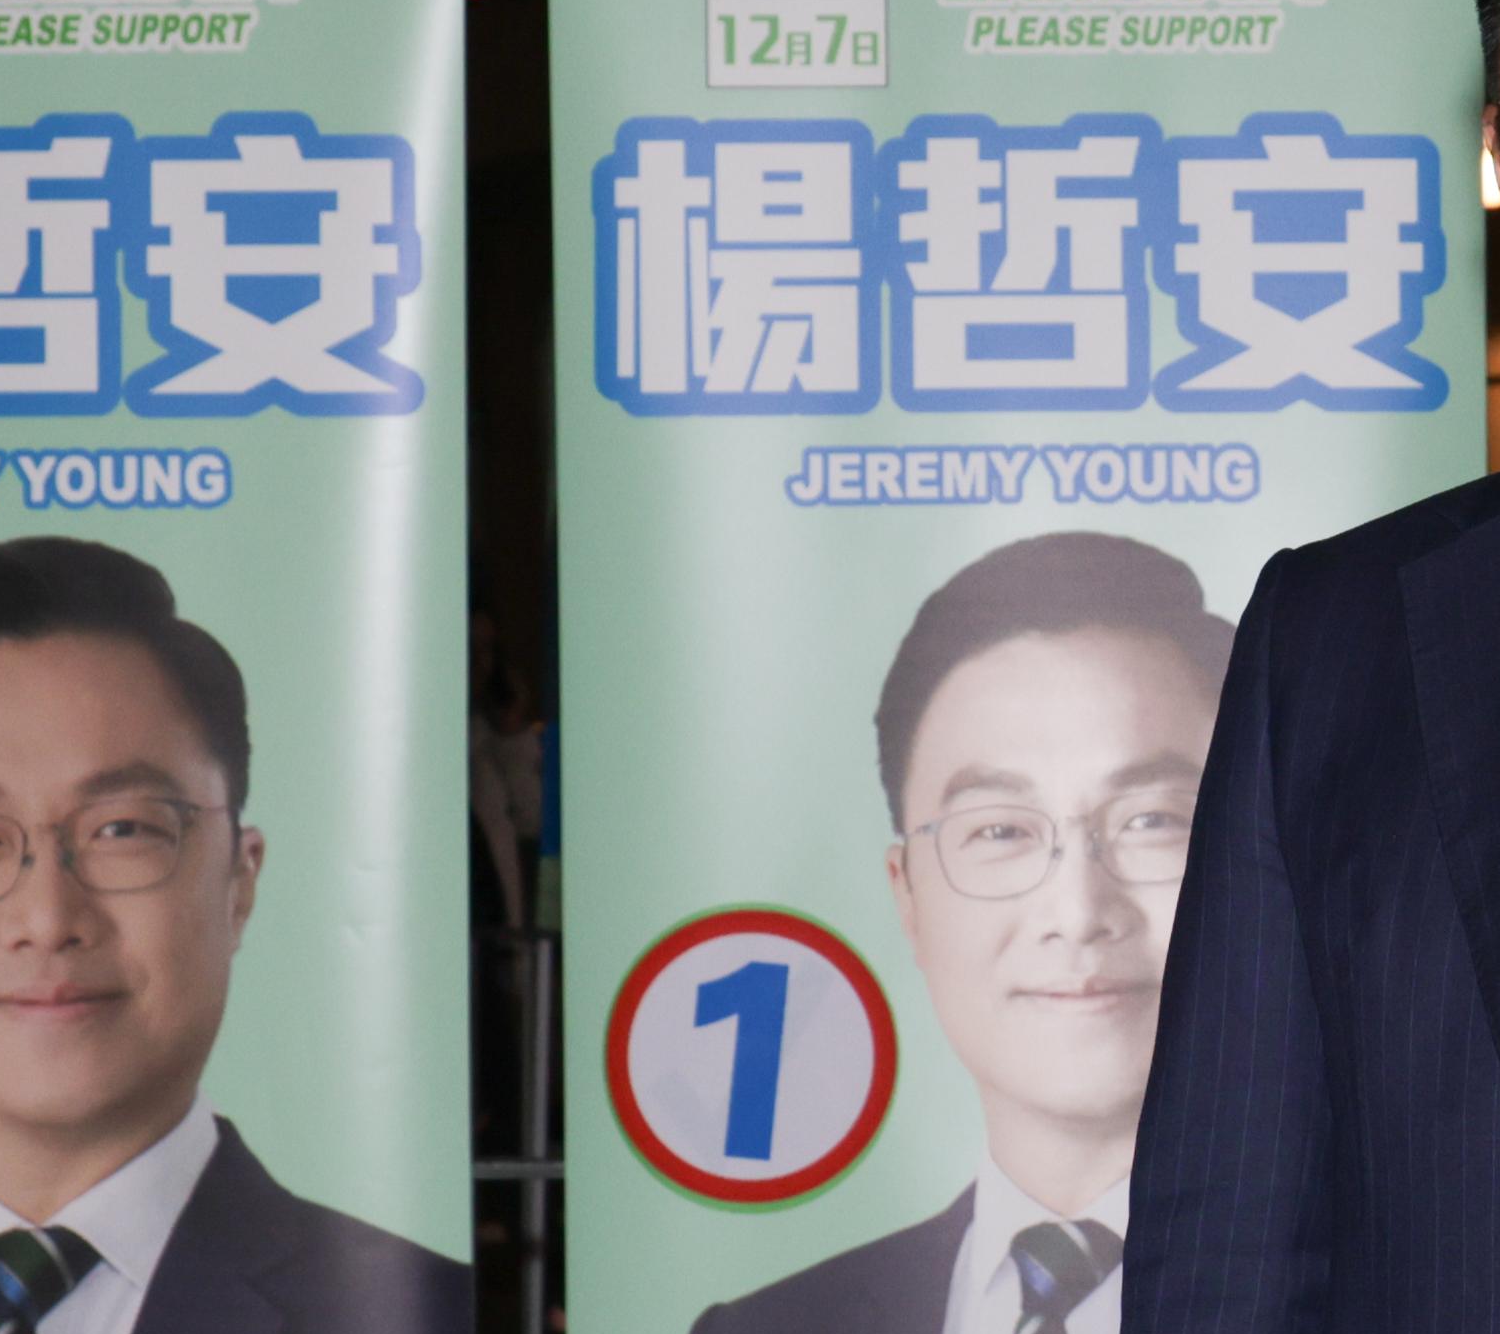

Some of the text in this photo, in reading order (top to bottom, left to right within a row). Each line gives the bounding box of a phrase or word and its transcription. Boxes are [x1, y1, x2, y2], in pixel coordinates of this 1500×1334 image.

[91, 11, 252, 45] SUPPORT
[717, 13, 879, 66] 12月7日
[972, 13, 1278, 48] PLEASE SUPPORT
[614, 134, 1425, 394] 楊哲安
[18, 455, 227, 503] YOUNG
[790, 451, 1254, 502] JEREMY YOUNG
[694, 961, 789, 1160] 1
